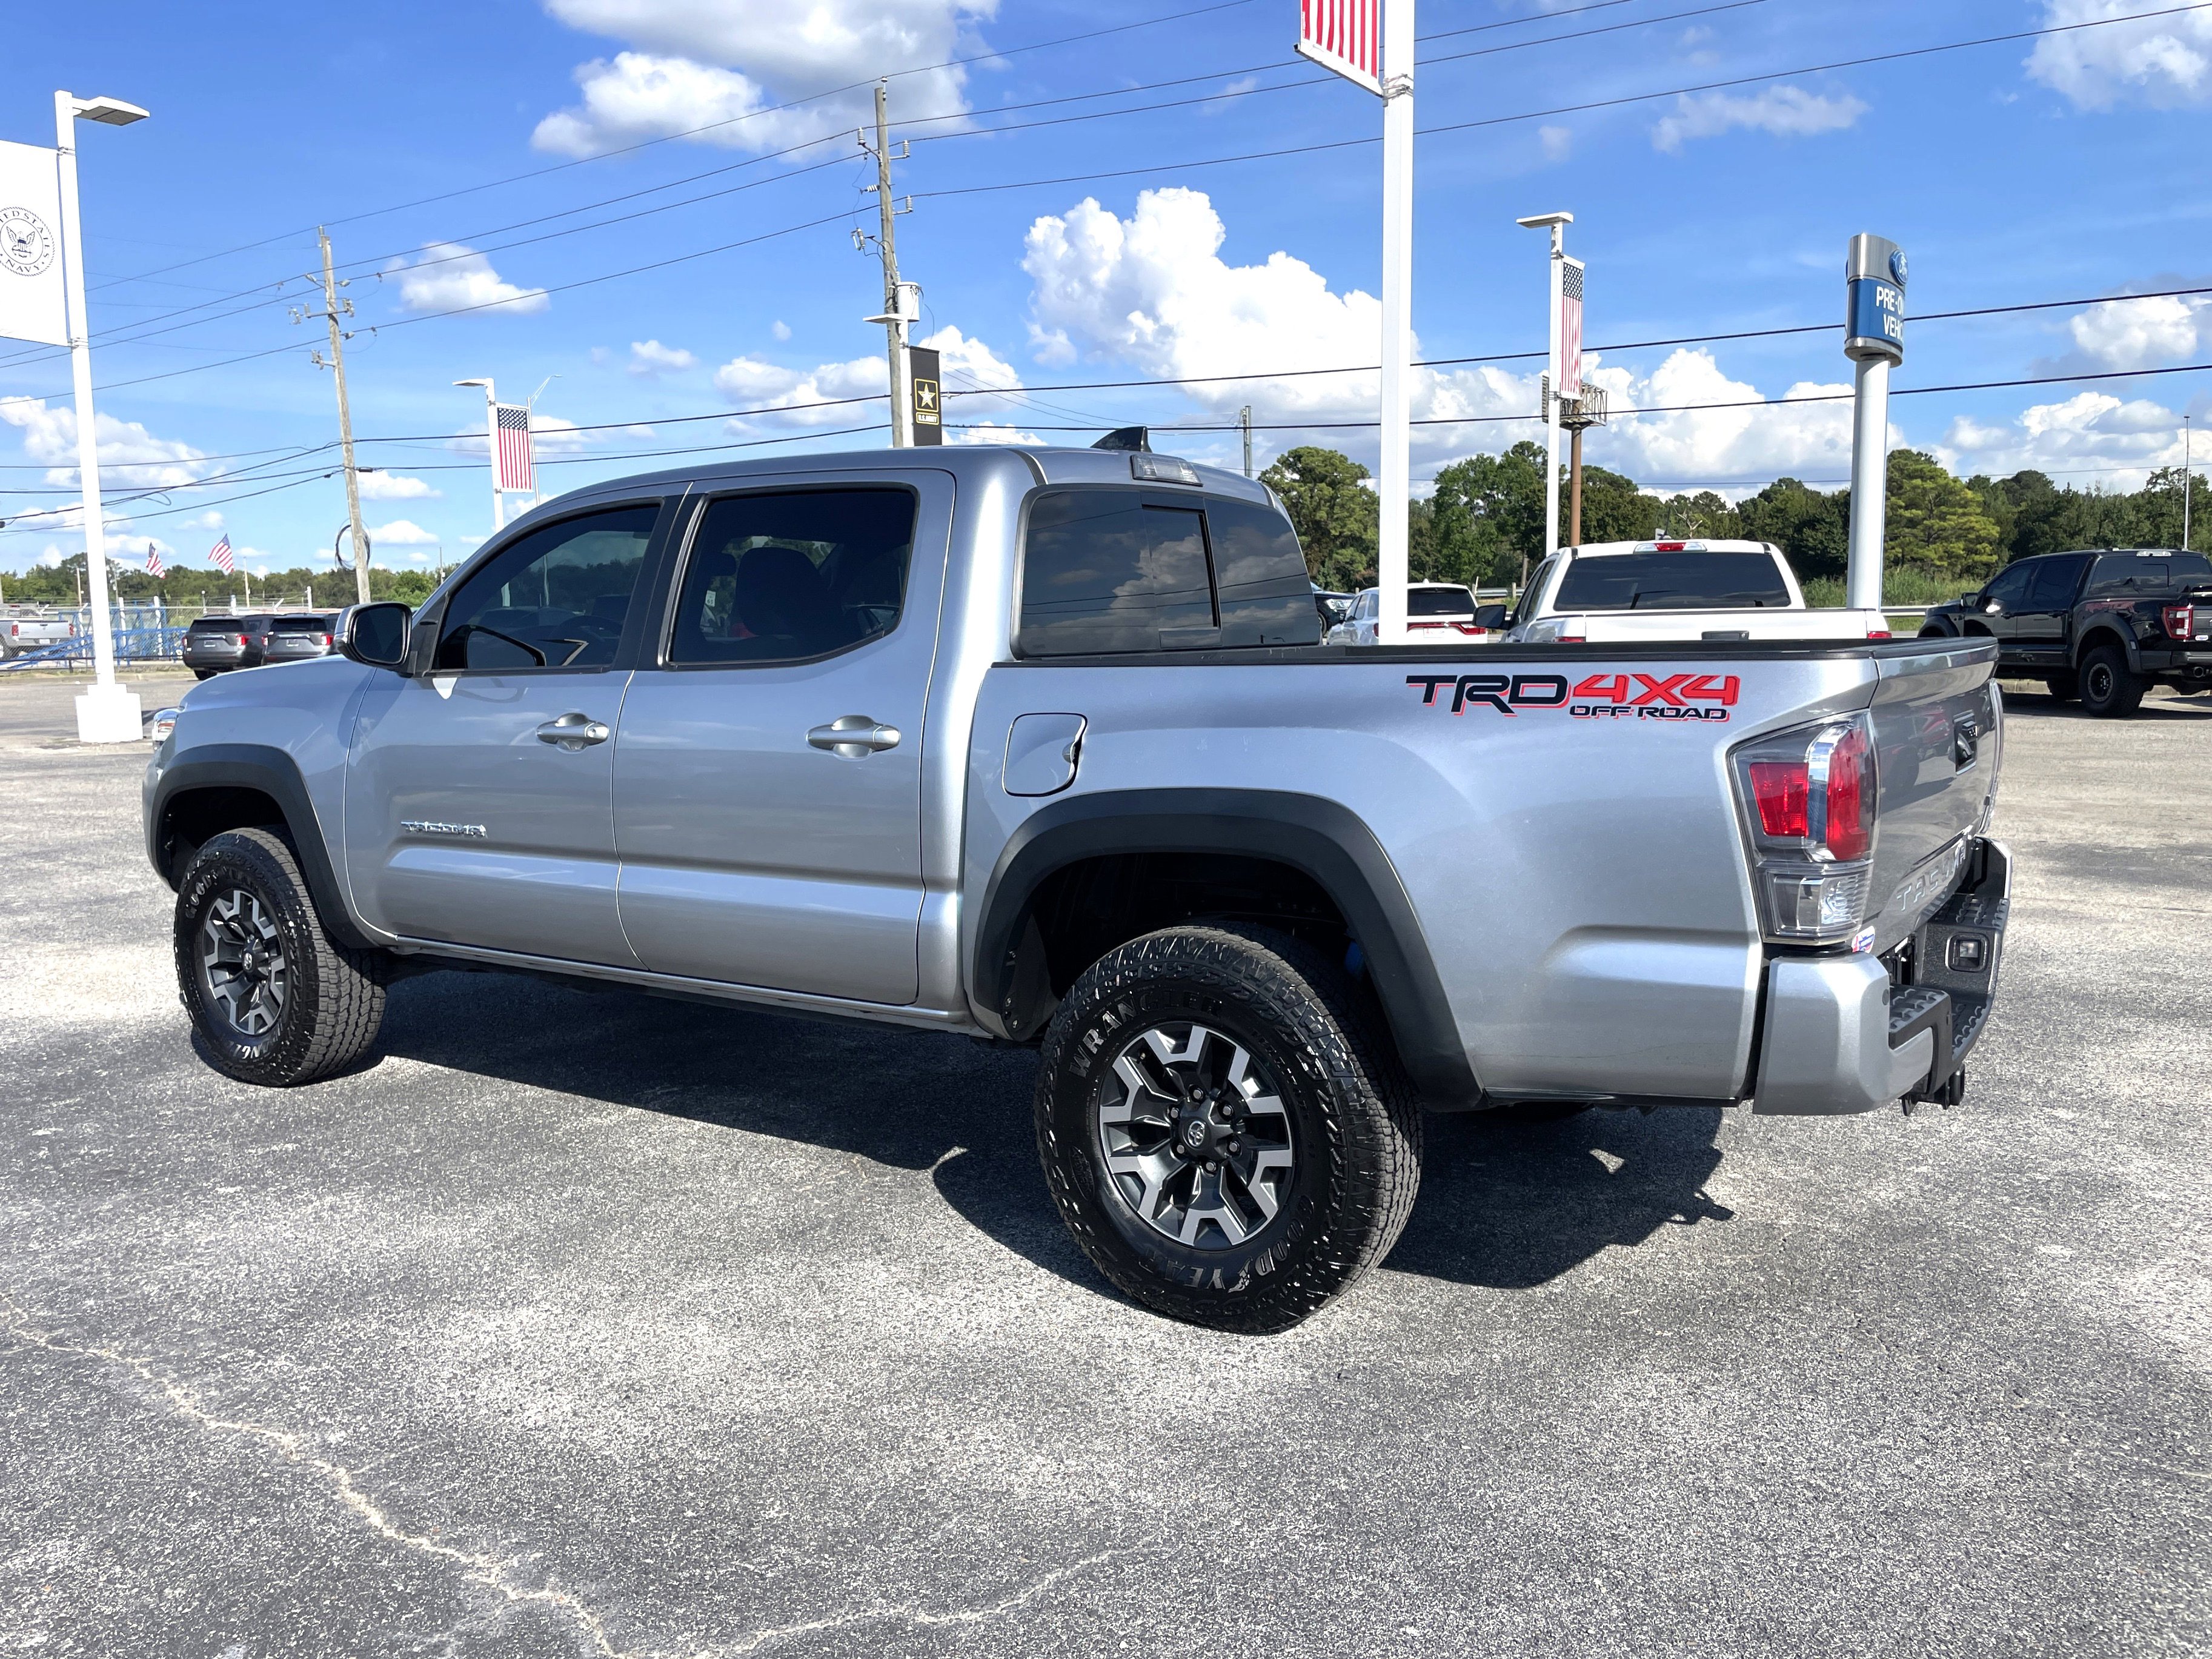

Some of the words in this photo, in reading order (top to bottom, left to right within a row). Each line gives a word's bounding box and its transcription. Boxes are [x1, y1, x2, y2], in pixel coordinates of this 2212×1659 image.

[5, 259, 40, 272] NAVY
[1406, 674, 1573, 717] TRD
[1569, 705, 1634, 719] OFF
[1637, 706, 1730, 722] ROAD
